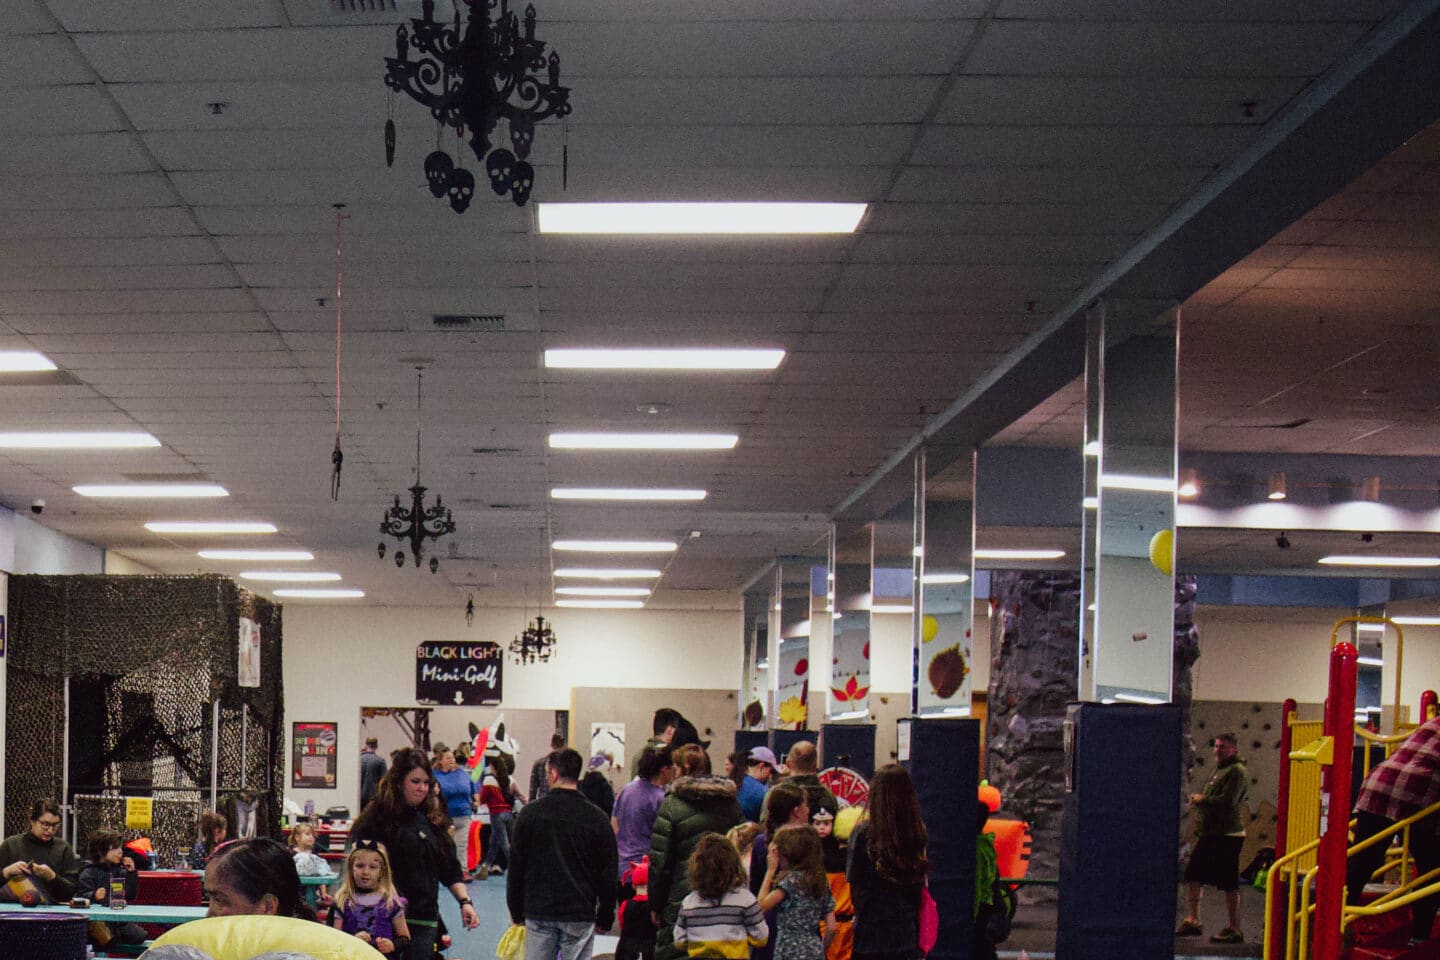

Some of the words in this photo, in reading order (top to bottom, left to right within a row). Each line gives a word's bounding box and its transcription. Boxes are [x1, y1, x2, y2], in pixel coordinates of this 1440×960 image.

[417, 646, 458, 659] BLACK
[460, 646, 503, 659] LIGHT
[422, 663, 497, 689] Mini-Golf
